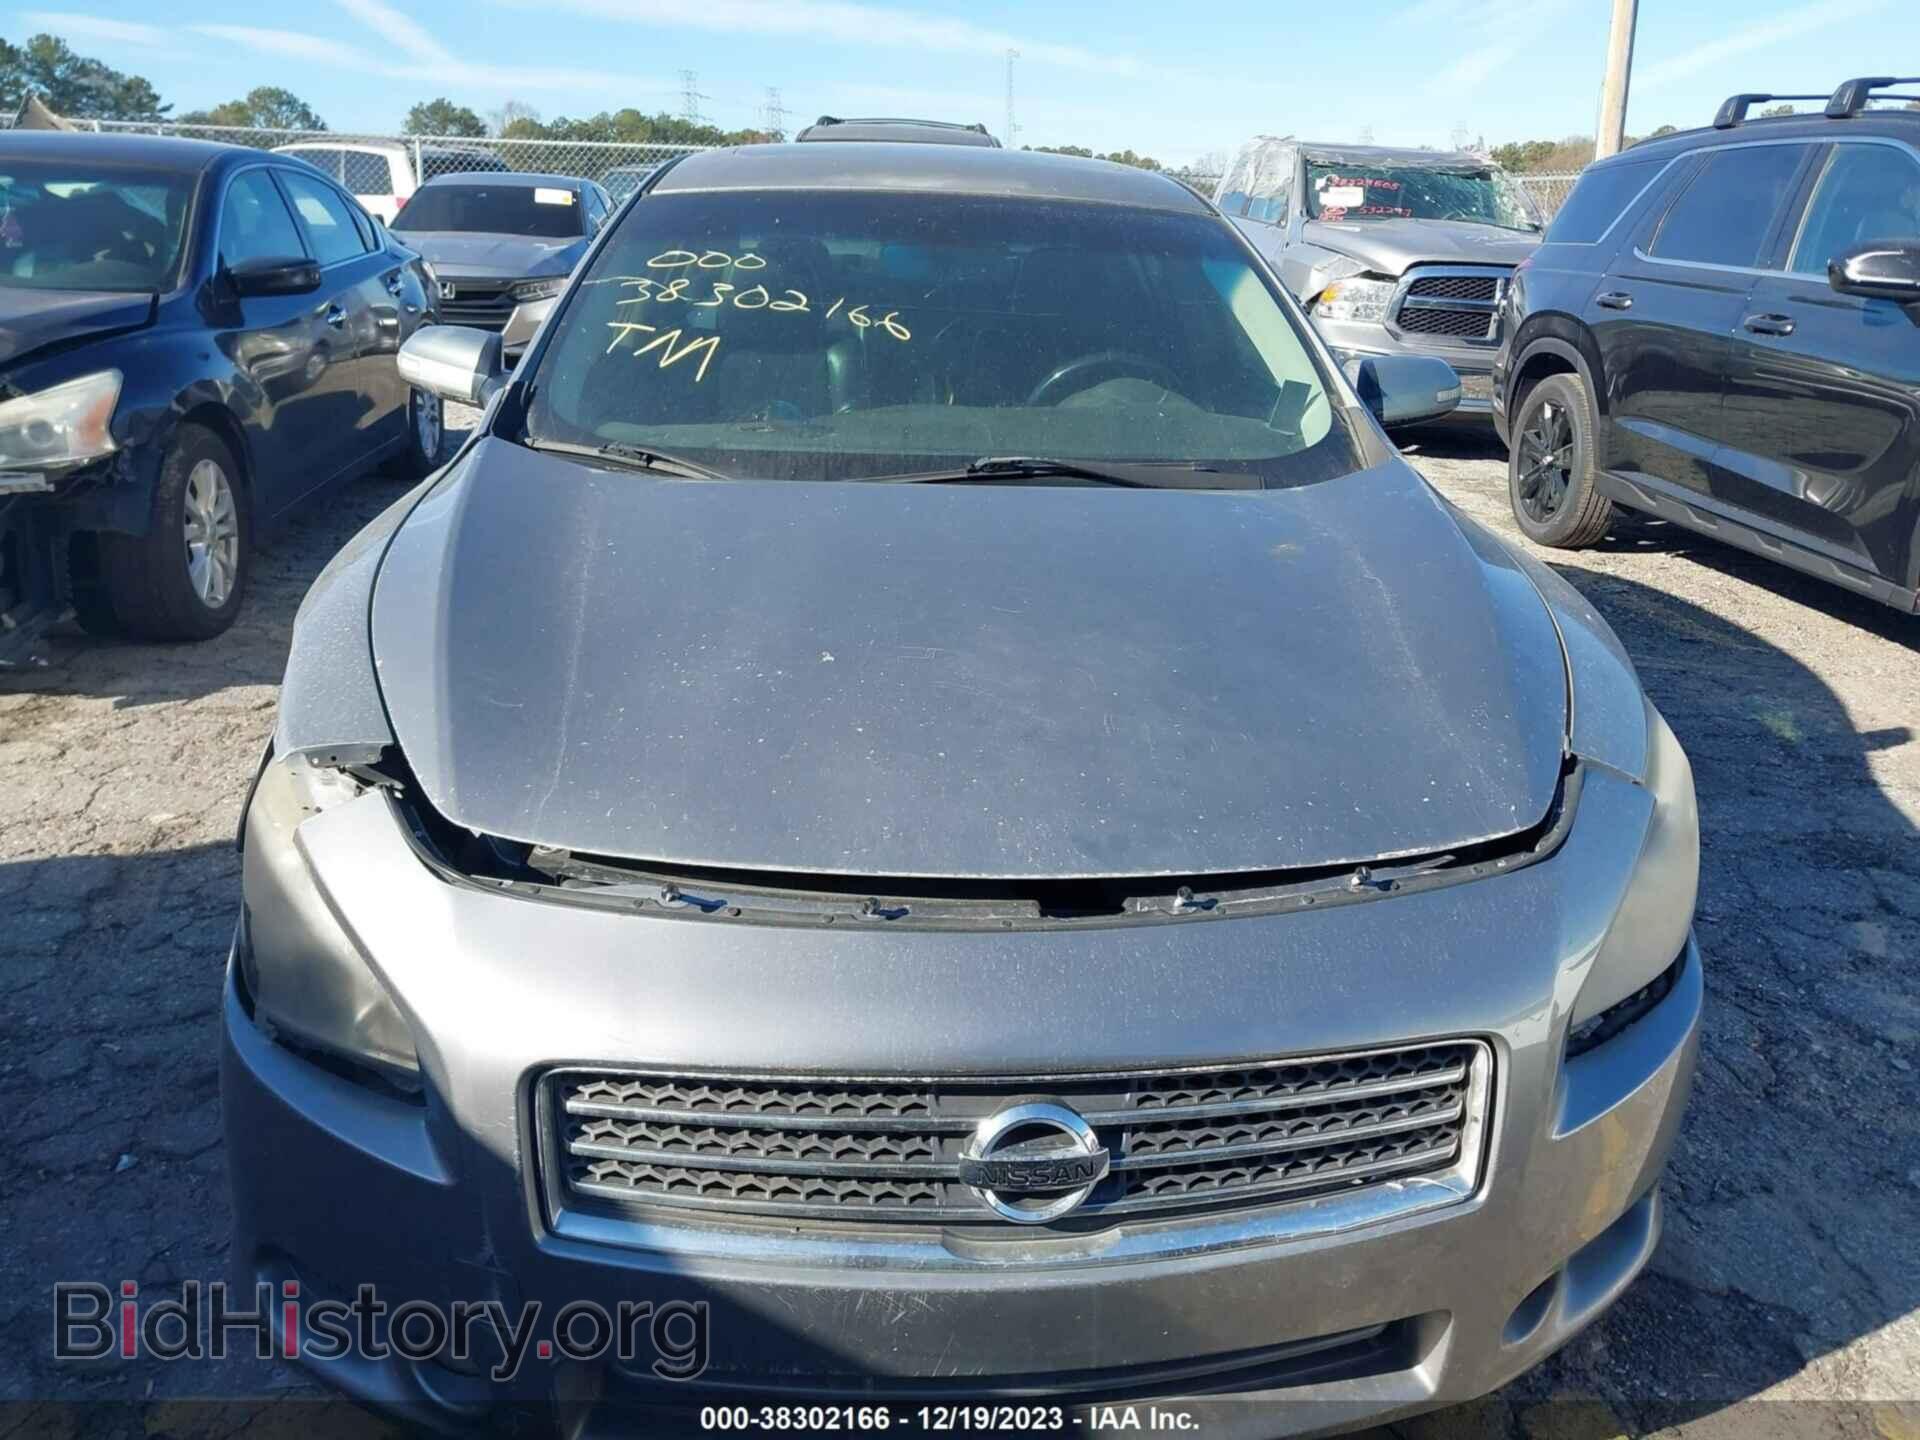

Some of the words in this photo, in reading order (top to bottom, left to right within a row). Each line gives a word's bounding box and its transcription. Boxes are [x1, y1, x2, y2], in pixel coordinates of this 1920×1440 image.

[647, 250, 766, 270] 000
[615, 278, 912, 341] 38302166
[976, 1161, 1095, 1186] NISSAN
